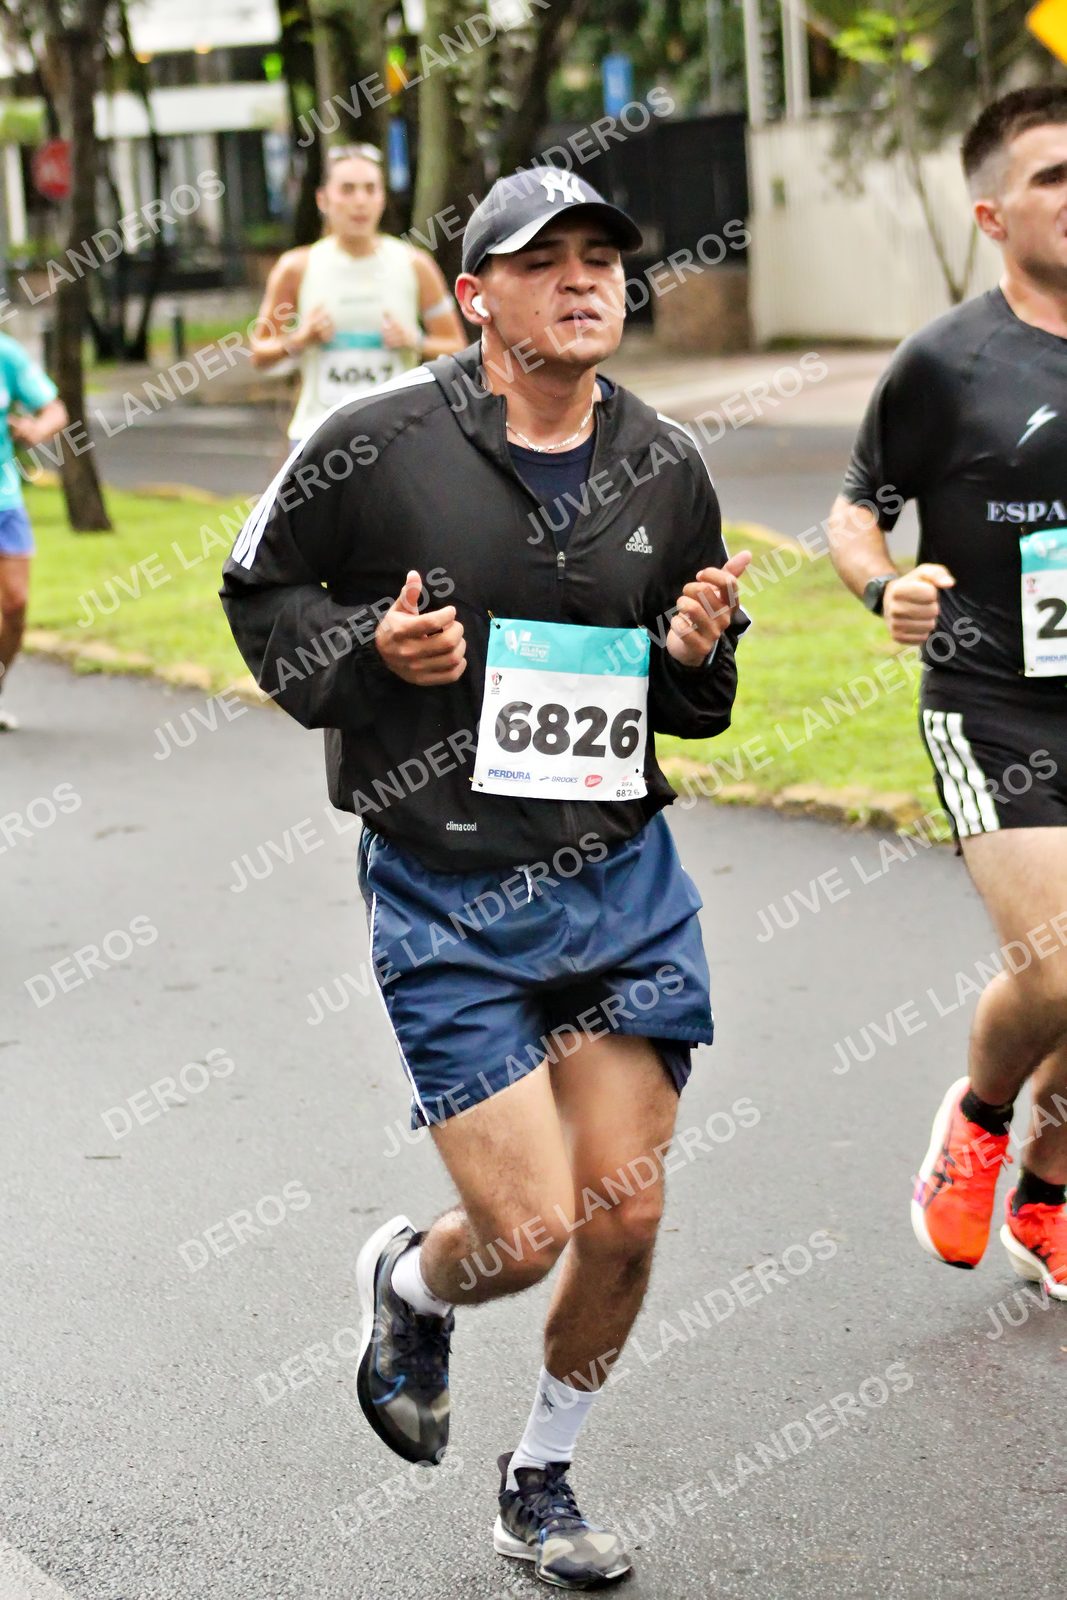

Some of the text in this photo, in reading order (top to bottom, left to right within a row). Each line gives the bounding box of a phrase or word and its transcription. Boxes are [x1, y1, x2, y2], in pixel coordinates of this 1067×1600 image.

[625, 542, 653, 554] adidas
[495, 701, 643, 759] 6826
[487, 768, 531, 781] PERDURA
[551, 775, 579, 784] BROOKS
